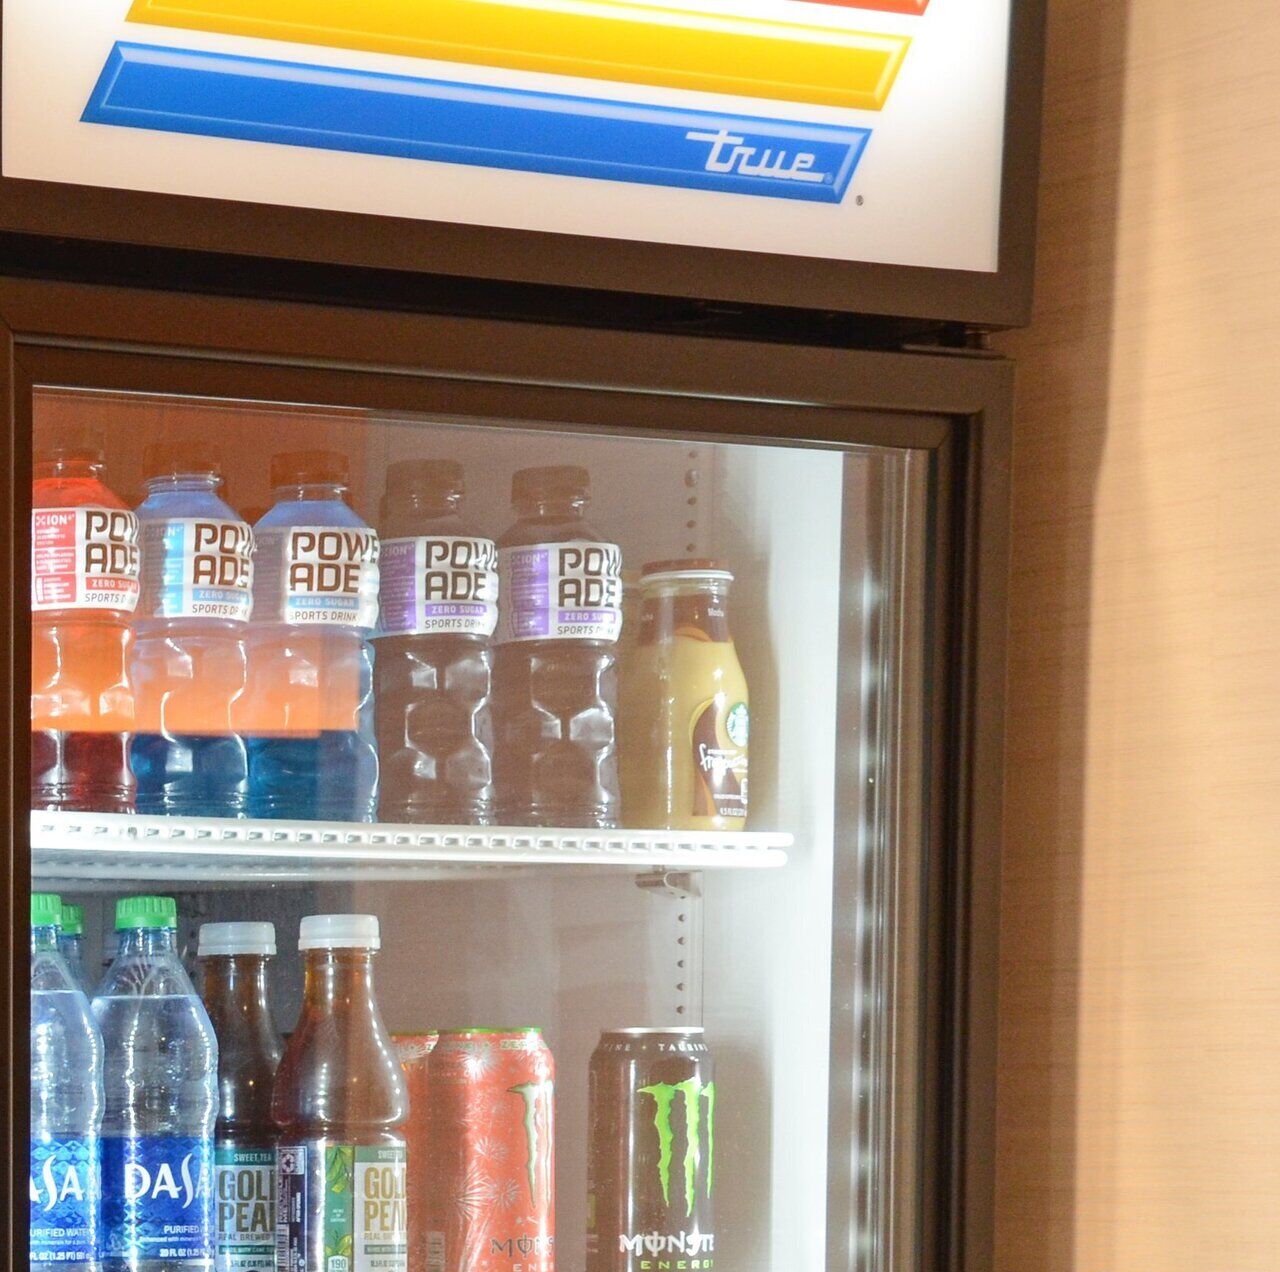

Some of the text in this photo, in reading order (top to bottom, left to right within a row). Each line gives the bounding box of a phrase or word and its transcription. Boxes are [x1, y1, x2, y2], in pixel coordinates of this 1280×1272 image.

[85, 543, 138, 575] ADE
[192, 554, 251, 588] ADE
[290, 563, 360, 593] ADE
[91, 579, 115, 589] ZERO
[425, 571, 487, 601] ADE
[85, 593, 121, 603] SPORTS
[559, 578, 617, 608] ADE
[432, 605, 457, 614] ZERO
[289, 611, 358, 622] SPORTS DRINK
[565, 612, 590, 622] ZERO
[425, 618, 462, 629] SPORTS
[557, 625, 592, 636] SPORTS
[234, 1154, 272, 1162] SWEET TEA
[364, 1201, 406, 1231] PEA
[164, 1225, 199, 1234] PURIFIED
[241, 1233, 271, 1241] BREWED
[330, 1259, 346, 1269] 190
